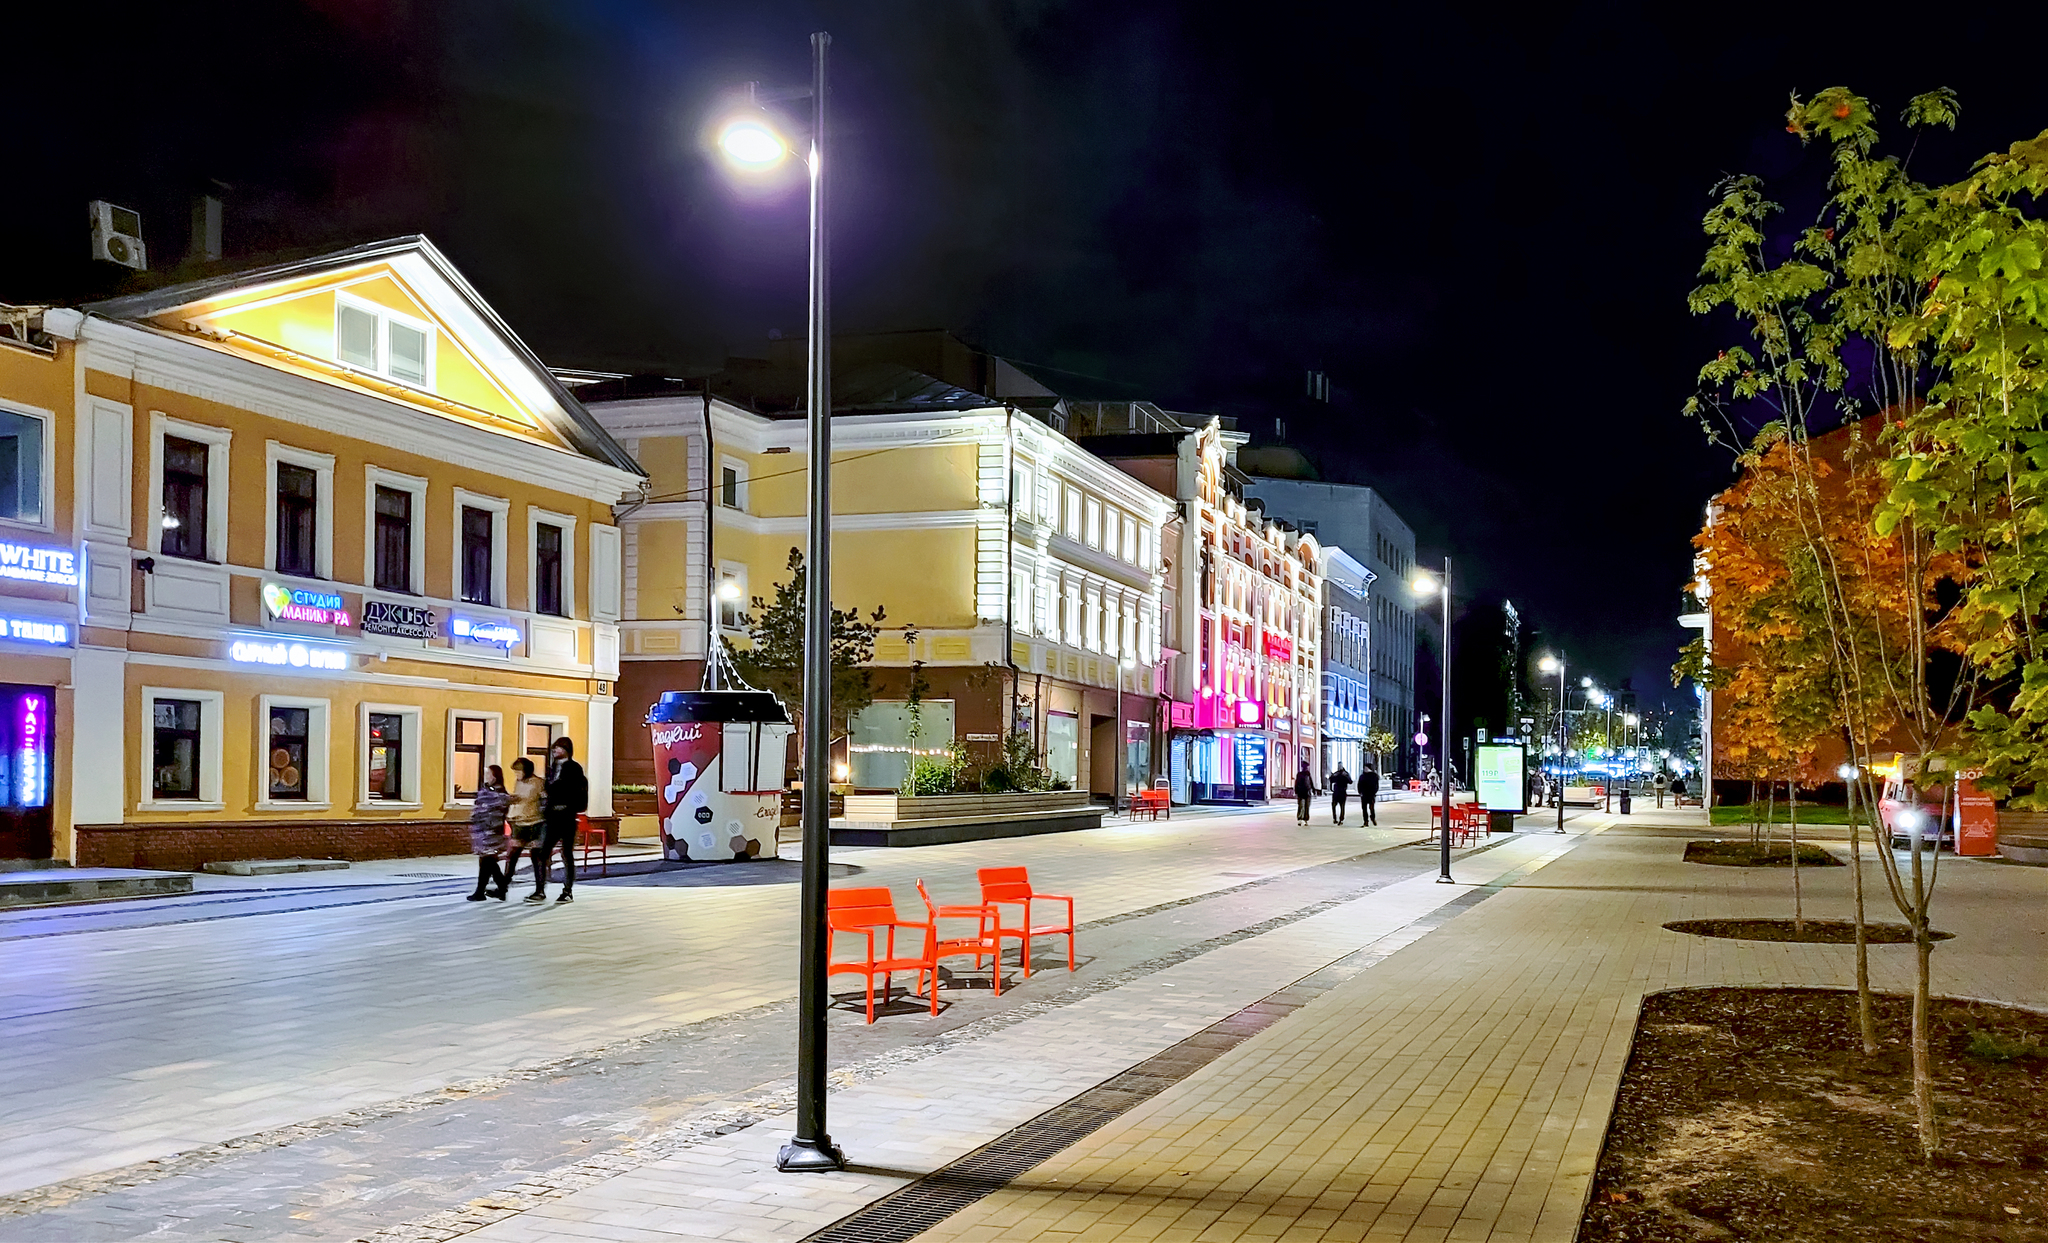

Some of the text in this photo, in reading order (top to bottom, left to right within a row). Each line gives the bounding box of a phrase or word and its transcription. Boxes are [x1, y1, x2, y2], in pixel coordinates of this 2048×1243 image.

[0, 543, 74, 574] WHITE
[293, 590, 342, 609] СТУДИЯ
[367, 602, 436, 626] ДЖОБС
[10, 619, 67, 644] ТАНЦА
[364, 623, 392, 632] РЕМОНТ
[397, 628, 437, 638] АКСЕССУАРЫ
